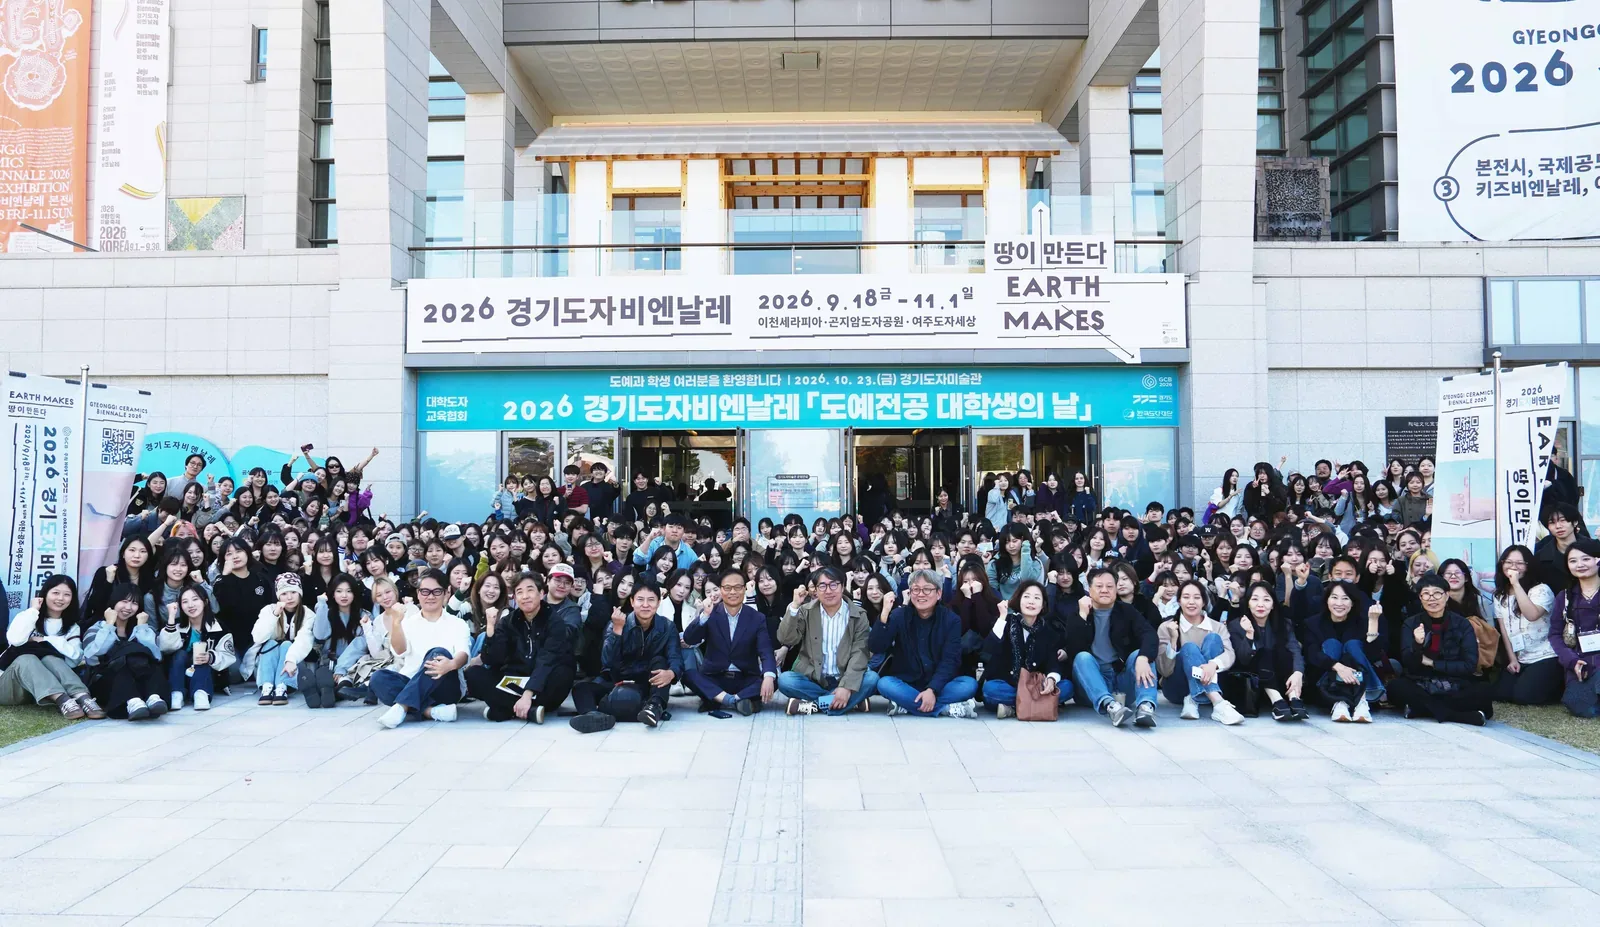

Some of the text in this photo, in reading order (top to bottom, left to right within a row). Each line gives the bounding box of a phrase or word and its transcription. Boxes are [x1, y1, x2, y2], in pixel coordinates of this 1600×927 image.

[1512, 23, 1600, 45] GYEONG
[1449, 49, 1574, 93] 2026
[49, 168, 71, 179] 2026
[1476, 157, 1534, 178] 본전시,
[1476, 176, 1589, 199] 키즈비엔날레,
[100, 226, 127, 240] 2026
[100, 240, 129, 252] KOREA
[993, 241, 1107, 265] 땅이 만든다
[1007, 275, 1100, 298] EARTH
[423, 294, 732, 327] 2026 경기도자비엔날레
[1004, 309, 1105, 331] MAKES
[609, 376, 645, 387] 도예과
[647, 375, 670, 387] 학생
[673, 375, 720, 387] 여러분을
[723, 374, 782, 387] 환영합니다
[900, 372, 982, 386] 경기도자미술관
[1466, 389, 1494, 398] CERAMICS
[1521, 384, 1543, 396] 2026
[9, 391, 74, 405] EARTH MAKES
[426, 396, 468, 407] 대학도자
[1506, 395, 1561, 408] 경기비엔날레
[8, 405, 46, 416] 땅이 만든다
[90, 401, 148, 414] GYEONGGI CERAMICS
[97, 409, 126, 417] BIENNALE
[503, 393, 574, 421] 2026
[584, 395, 800, 422] 경기도자비엔날레
[936, 392, 1044, 420] 대학생의
[426, 410, 467, 422] 교육협회
[1536, 416, 1551, 483] EAR
[1512, 469, 1531, 503] 땅이
[35, 426, 60, 597] 2026 경기도자비엔
